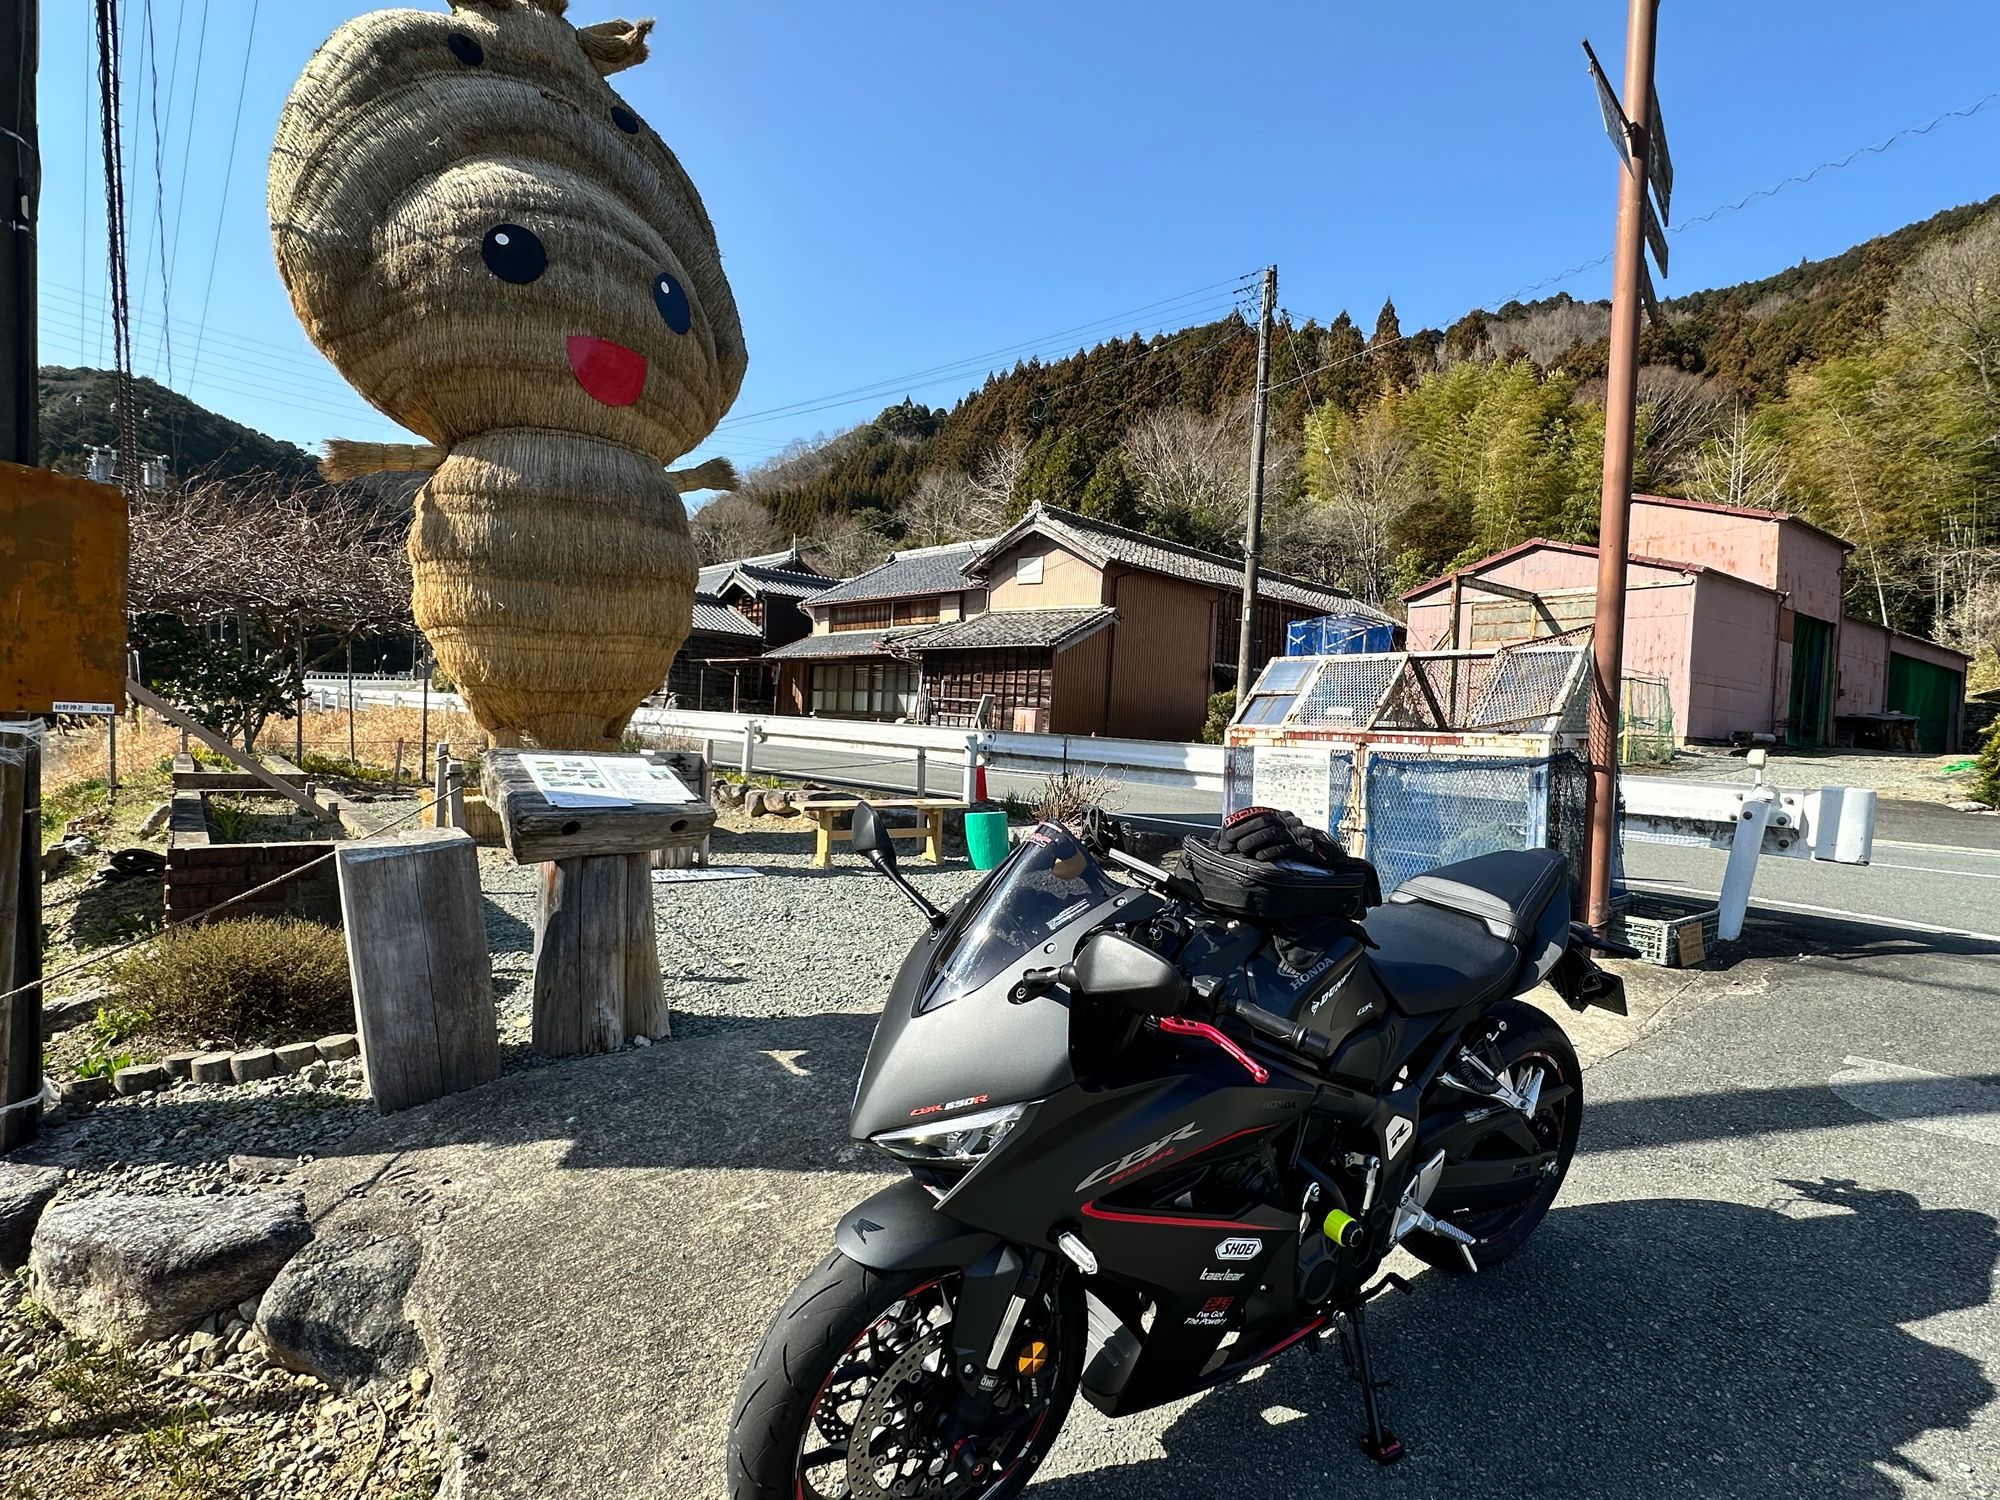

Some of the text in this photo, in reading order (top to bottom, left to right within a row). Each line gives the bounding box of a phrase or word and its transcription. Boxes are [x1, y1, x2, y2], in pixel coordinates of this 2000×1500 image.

[1289, 956, 1336, 992] HONDA
[944, 1092, 990, 1111] 650R
[1074, 1120, 1205, 1193] CBR
[1222, 1243, 1257, 1255] SHOEI
